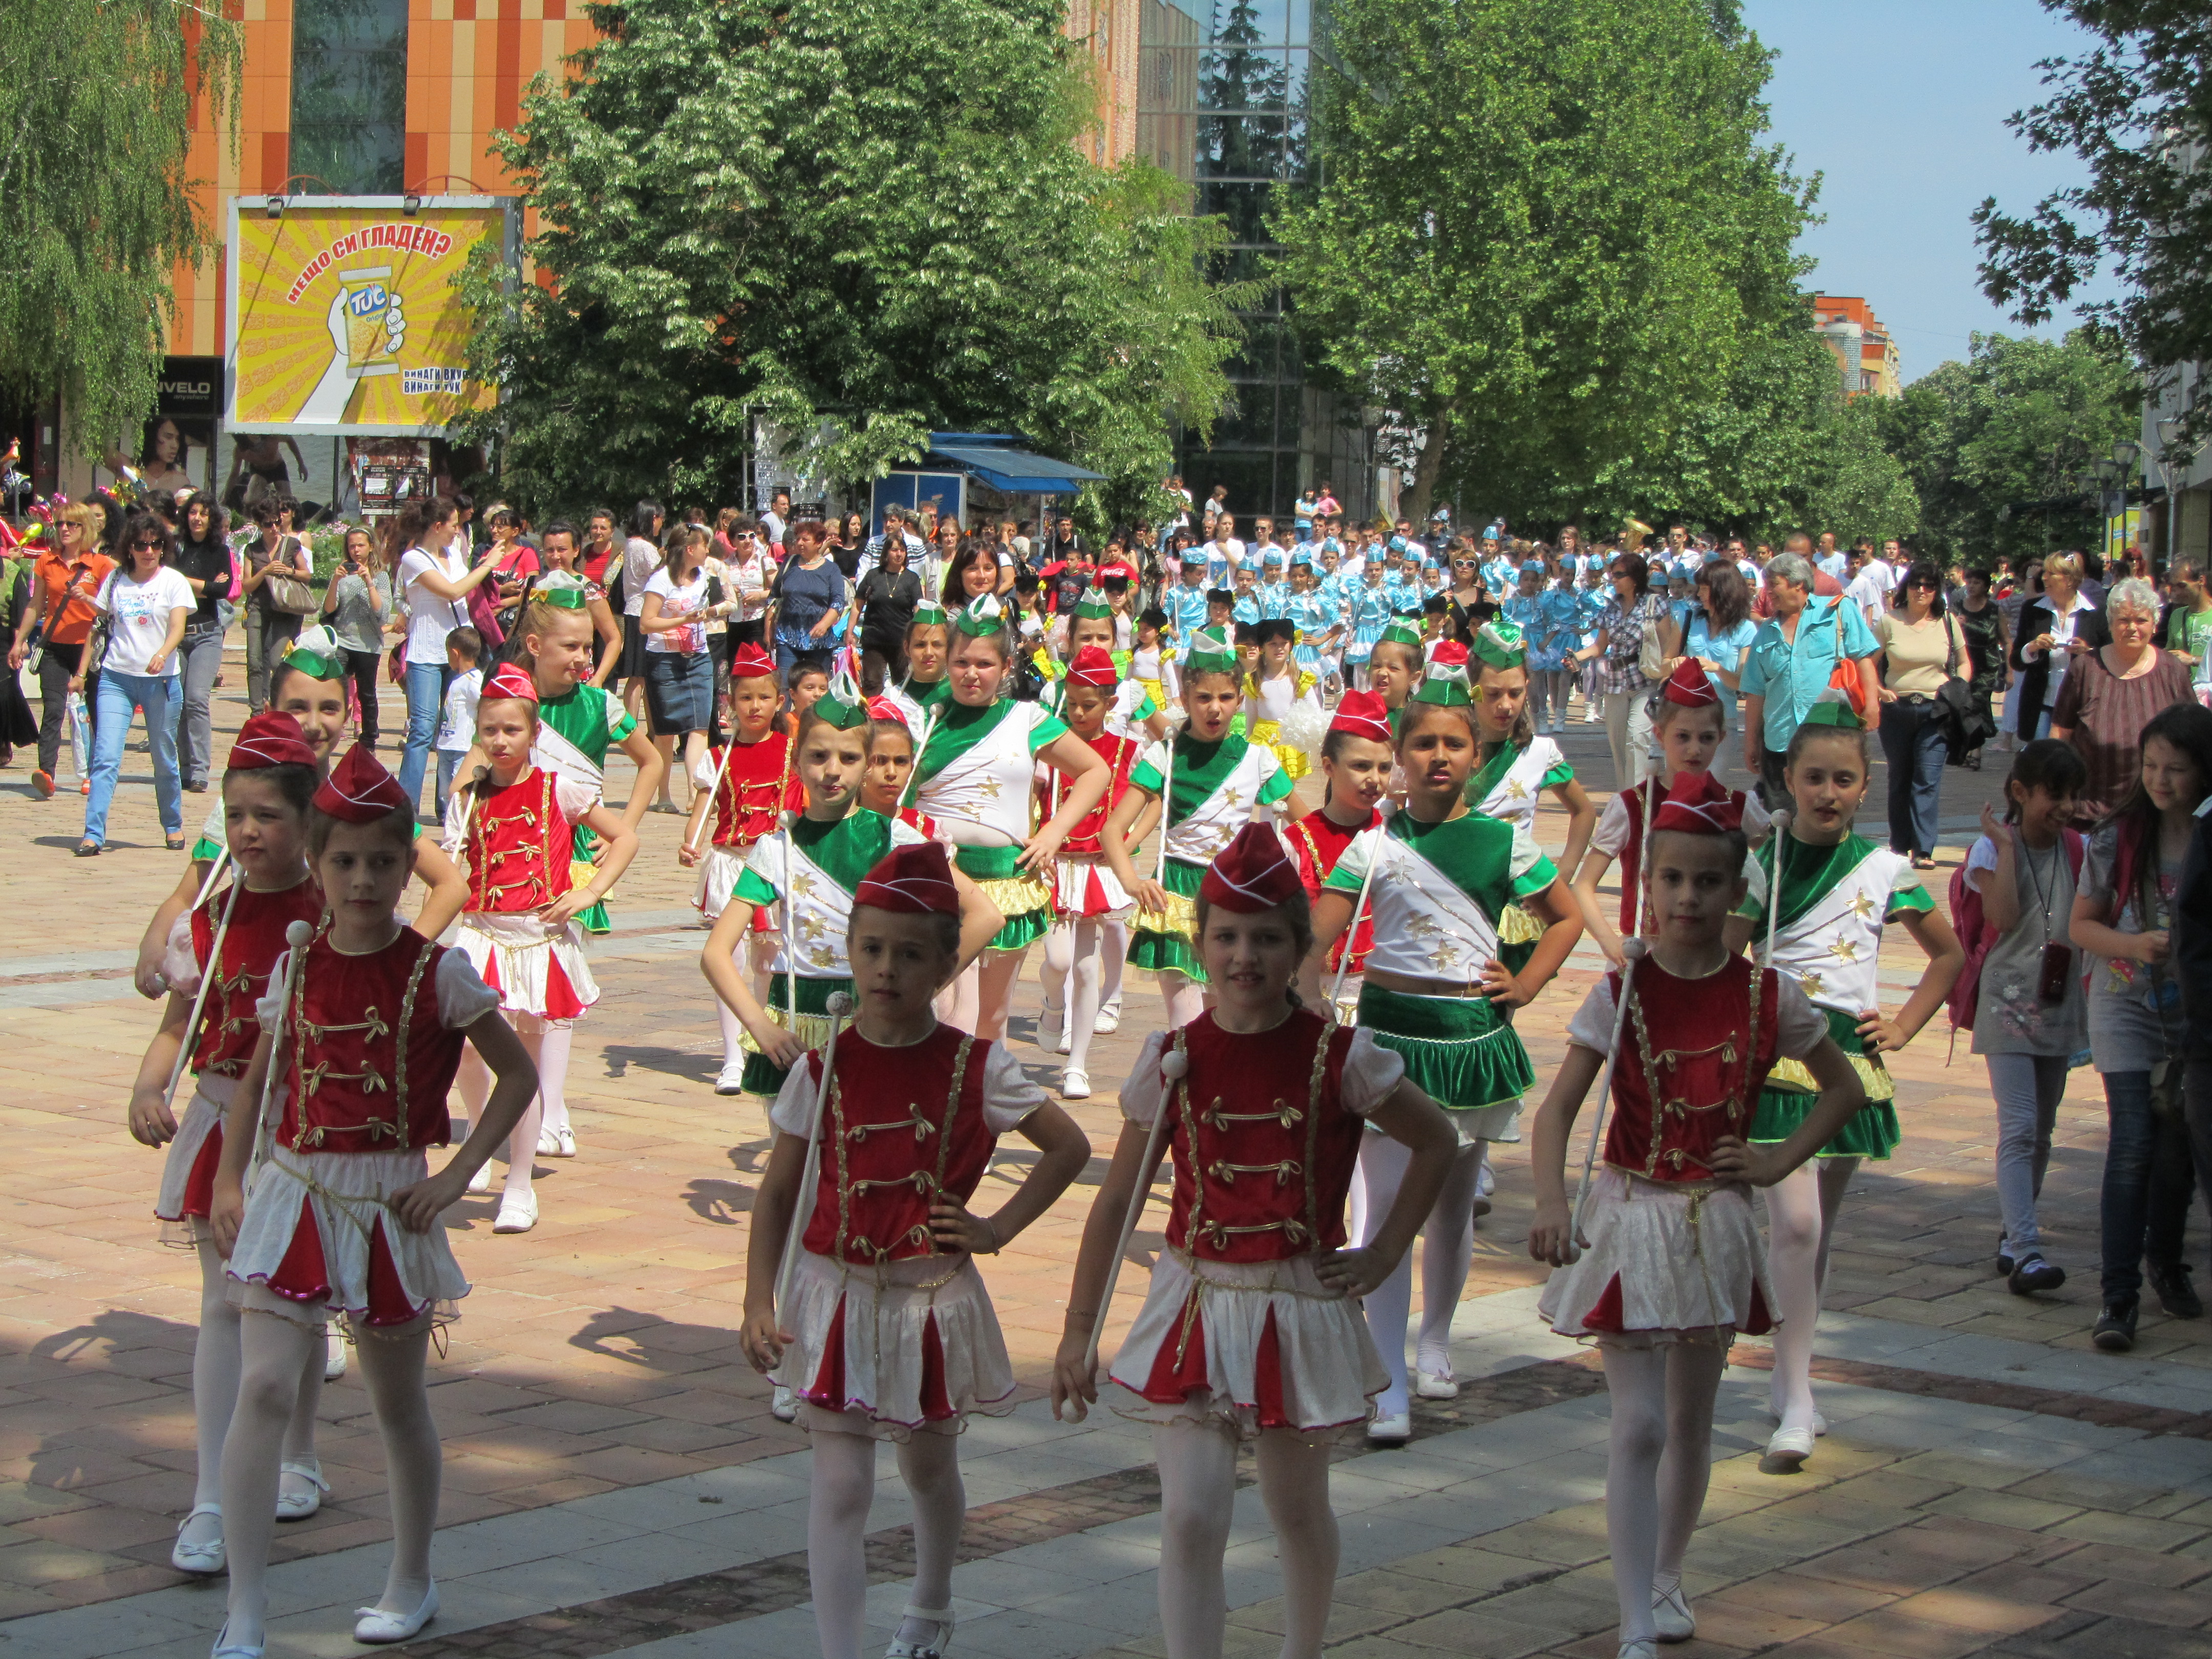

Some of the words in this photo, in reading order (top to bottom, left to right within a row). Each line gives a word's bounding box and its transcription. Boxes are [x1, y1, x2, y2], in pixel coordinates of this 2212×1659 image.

[287, 250, 332, 304] НЕЩО
[331, 233, 358, 259] СИ
[359, 224, 453, 260] ГЛАДЕН?
[351, 288, 386, 315] TUC
[404, 368, 441, 381] ВИНАГИ
[404, 381, 441, 393] ВИНАГИ
[443, 381, 461, 394] ТУК
